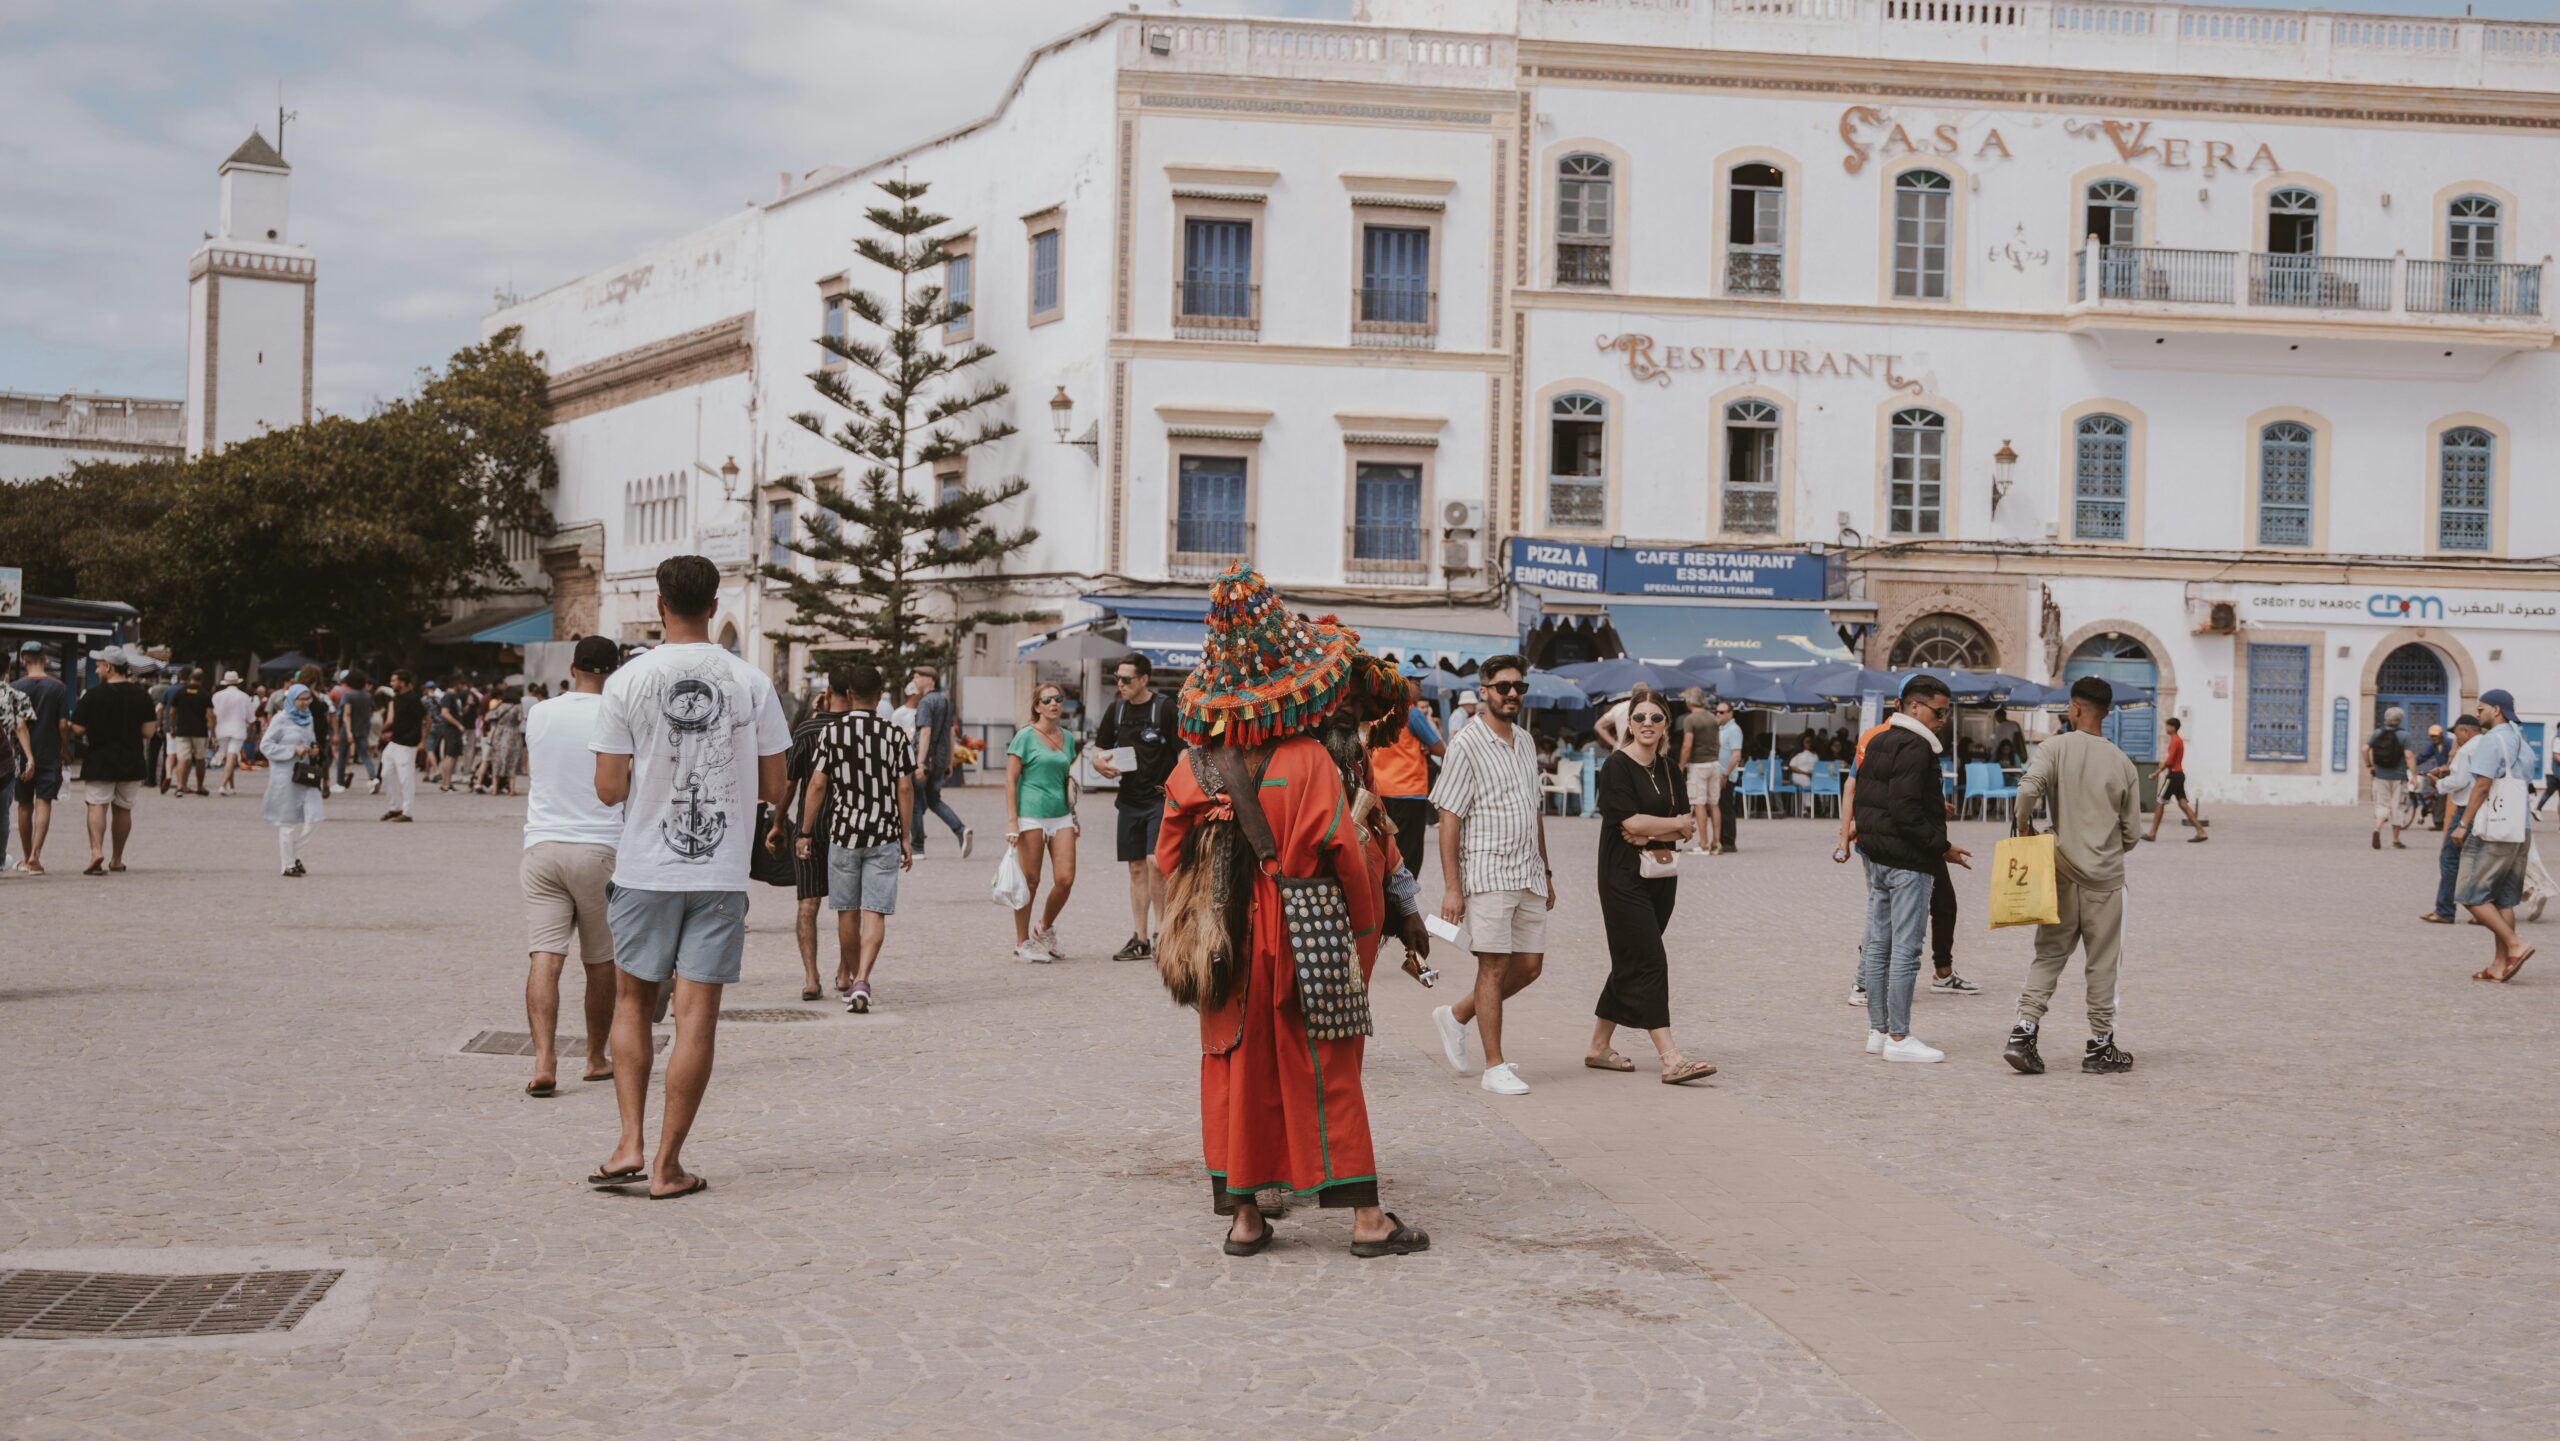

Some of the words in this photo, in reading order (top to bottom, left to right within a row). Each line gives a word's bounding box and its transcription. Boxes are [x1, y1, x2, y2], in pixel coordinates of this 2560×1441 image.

[1839, 105, 2012, 174] CASA
[2064, 118, 2283, 173] VERA
[1597, 333, 1923, 394] RESTAURANT
[1527, 545, 1573, 565] PIZZA
[1635, 551, 1679, 565] CAFE
[1683, 552, 1796, 569] RESTAURANT
[1515, 566, 1598, 590] EMPORTER
[1676, 568, 1754, 583] ESSALAM
[1644, 583, 1696, 593] SPECIALITE
[1698, 585, 1725, 594] PIZZA
[1727, 587, 1774, 596] ITALIENNE
[2253, 596, 2295, 608] CRÉDIT
[2299, 599, 2314, 609] DU
[2319, 600, 2361, 610] MAROC
[2448, 600, 2504, 616] المغرب
[2508, 603, 2557, 618] مصرف
[1704, 637, 1762, 649] Iconic
